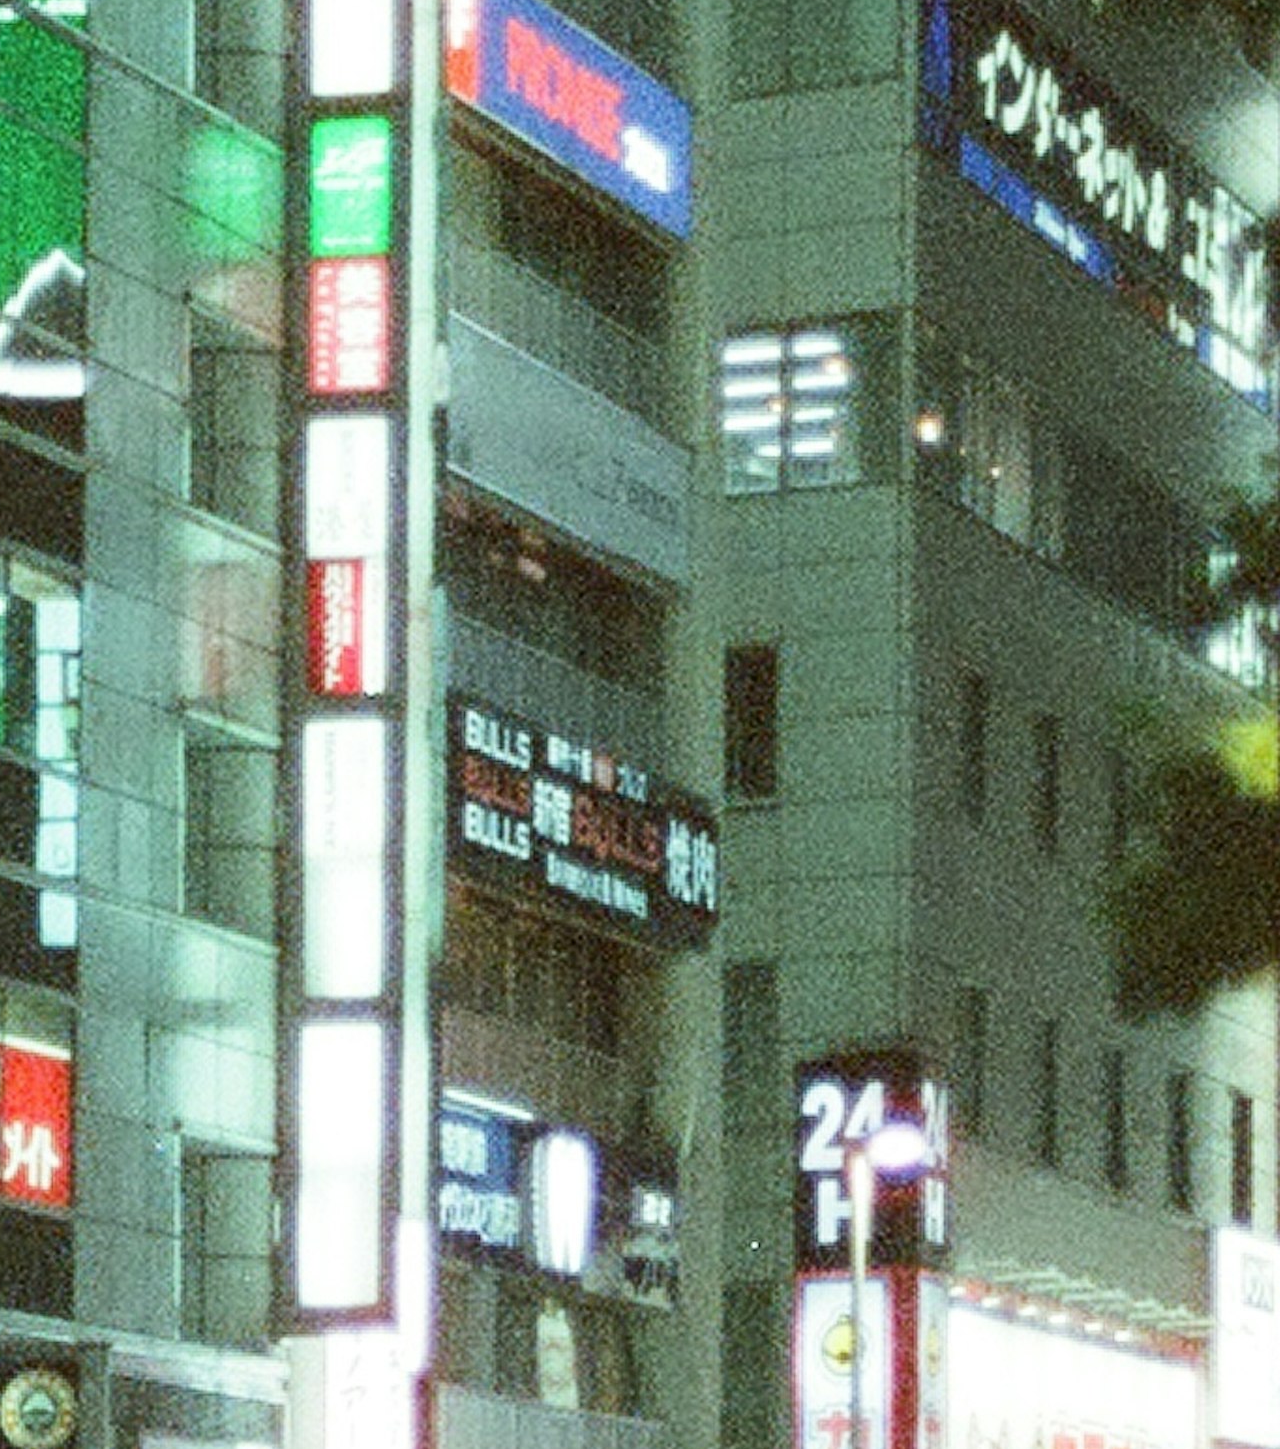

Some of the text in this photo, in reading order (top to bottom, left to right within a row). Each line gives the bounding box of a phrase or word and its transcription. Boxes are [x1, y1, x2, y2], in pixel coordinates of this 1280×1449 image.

[464, 708, 531, 770] BULLS
[464, 802, 531, 859] BULLS
[800, 1079, 884, 1171] 24
